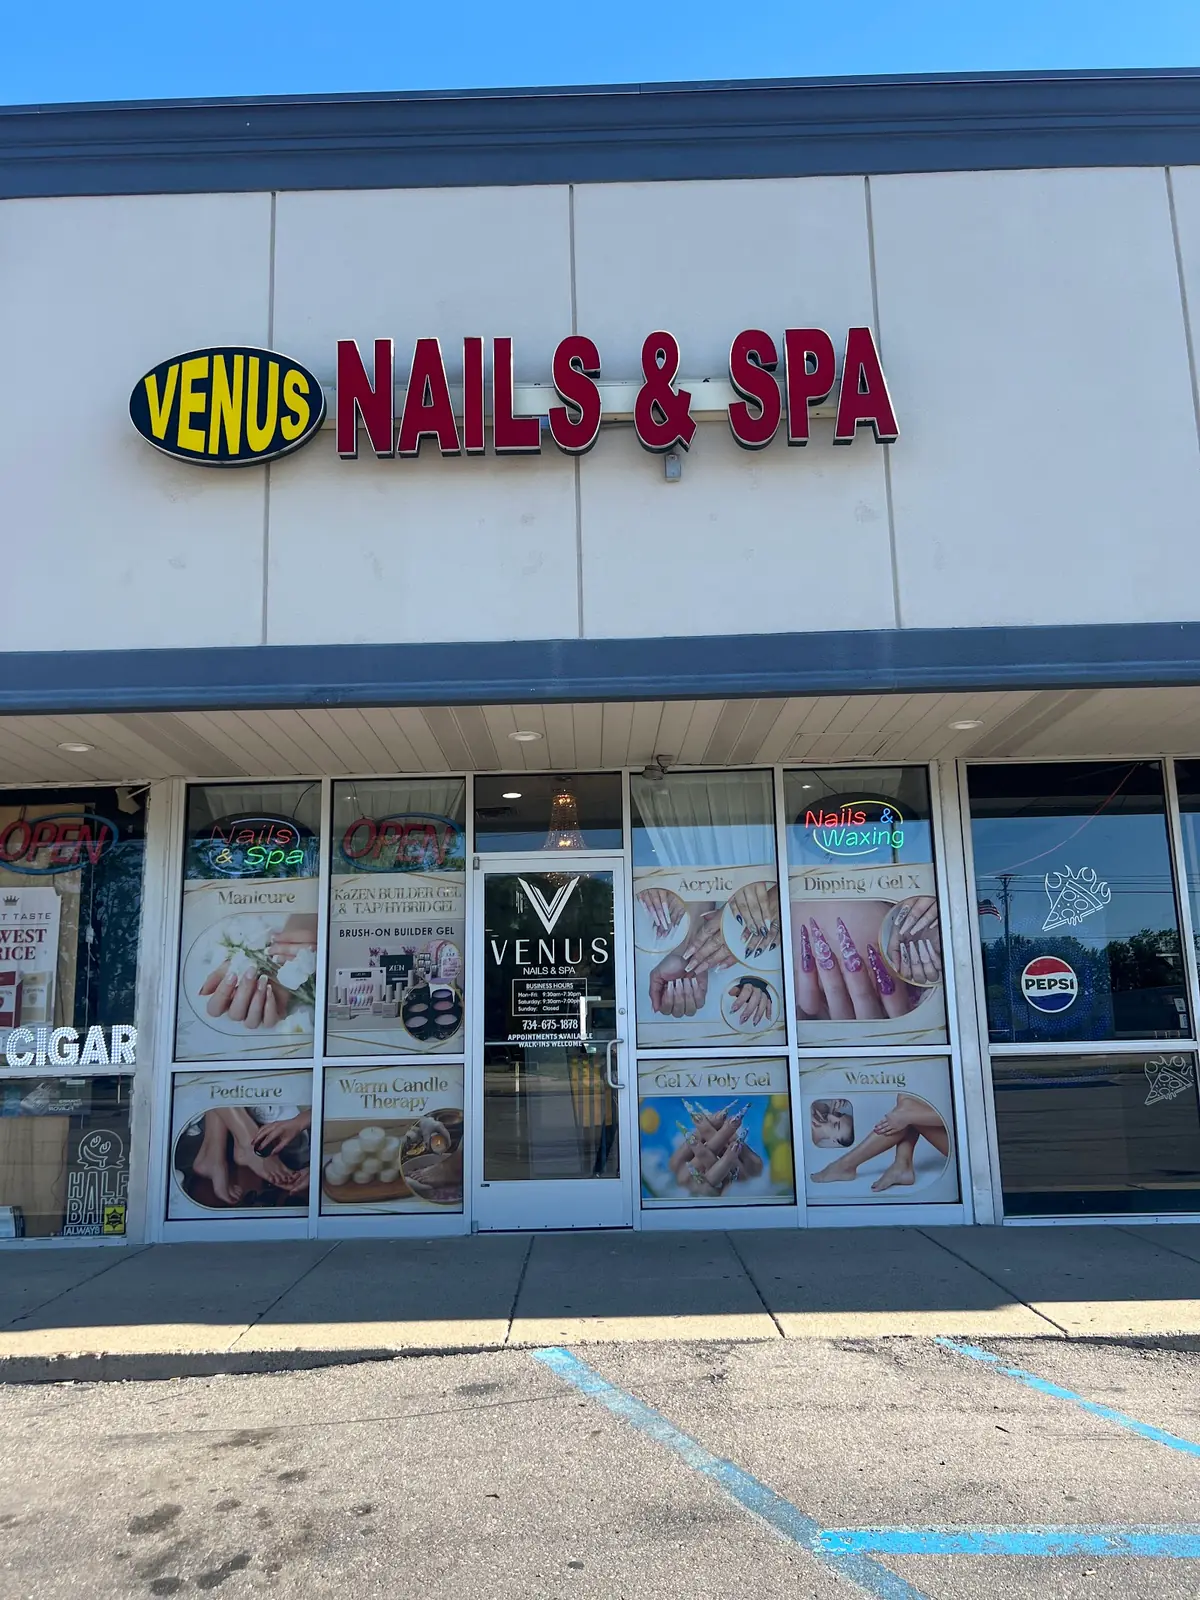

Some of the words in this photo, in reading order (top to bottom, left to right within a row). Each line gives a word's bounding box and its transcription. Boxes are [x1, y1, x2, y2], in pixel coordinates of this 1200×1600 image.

[336, 336, 602, 456] NAILS
[634, 329, 698, 452] &
[728, 326, 901, 450] SPA
[144, 354, 310, 456] VENUS
[805, 808, 867, 828] Nails
[880, 807, 894, 824] &
[0, 820, 108, 865] OPEN
[210, 824, 293, 846] Nails
[343, 818, 454, 865] OPEN
[822, 826, 905, 849] Waxing
[216, 848, 233, 865] &
[244, 846, 304, 869] Spa
[678, 876, 733, 894] Acrylic
[803, 876, 866, 894] Dipping
[877, 875, 903, 889] Gel
[908, 874, 920, 889] X
[218, 890, 296, 905] Manicure
[379, 886, 434, 900] BUILDER
[436, 886, 462, 899] GEL
[338, 902, 347, 914] &
[433, 900, 456, 912] GEL
[13, 912, 52, 921] TASTE
[339, 928, 391, 938] BRUSH-ON
[394, 927, 433, 936] BUILDER
[436, 926, 455, 935] GEL
[490, 937, 609, 966] VENUS
[523, 967, 549, 975] NAILS
[550, 966, 557, 975] &
[558, 966, 576, 975] SPA
[1024, 978, 1075, 991] PEPSI
[522, 1019, 579, 1030] 734-675-1878
[6, 1025, 137, 1066] CIGAR
[507, 1033, 557, 1041] APPOINTMENTS
[551, 1040, 583, 1048] WELCOME
[339, 1079, 388, 1093] Warm
[392, 1077, 448, 1093] Candle
[655, 1074, 681, 1088] Gel
[707, 1073, 740, 1090] Poly
[744, 1072, 771, 1087] Gel
[845, 1071, 906, 1087] Waxing
[210, 1085, 283, 1099] Pedicure
[360, 1094, 430, 1112] Therapy
[66, 1226, 101, 1236] ALWAYS
